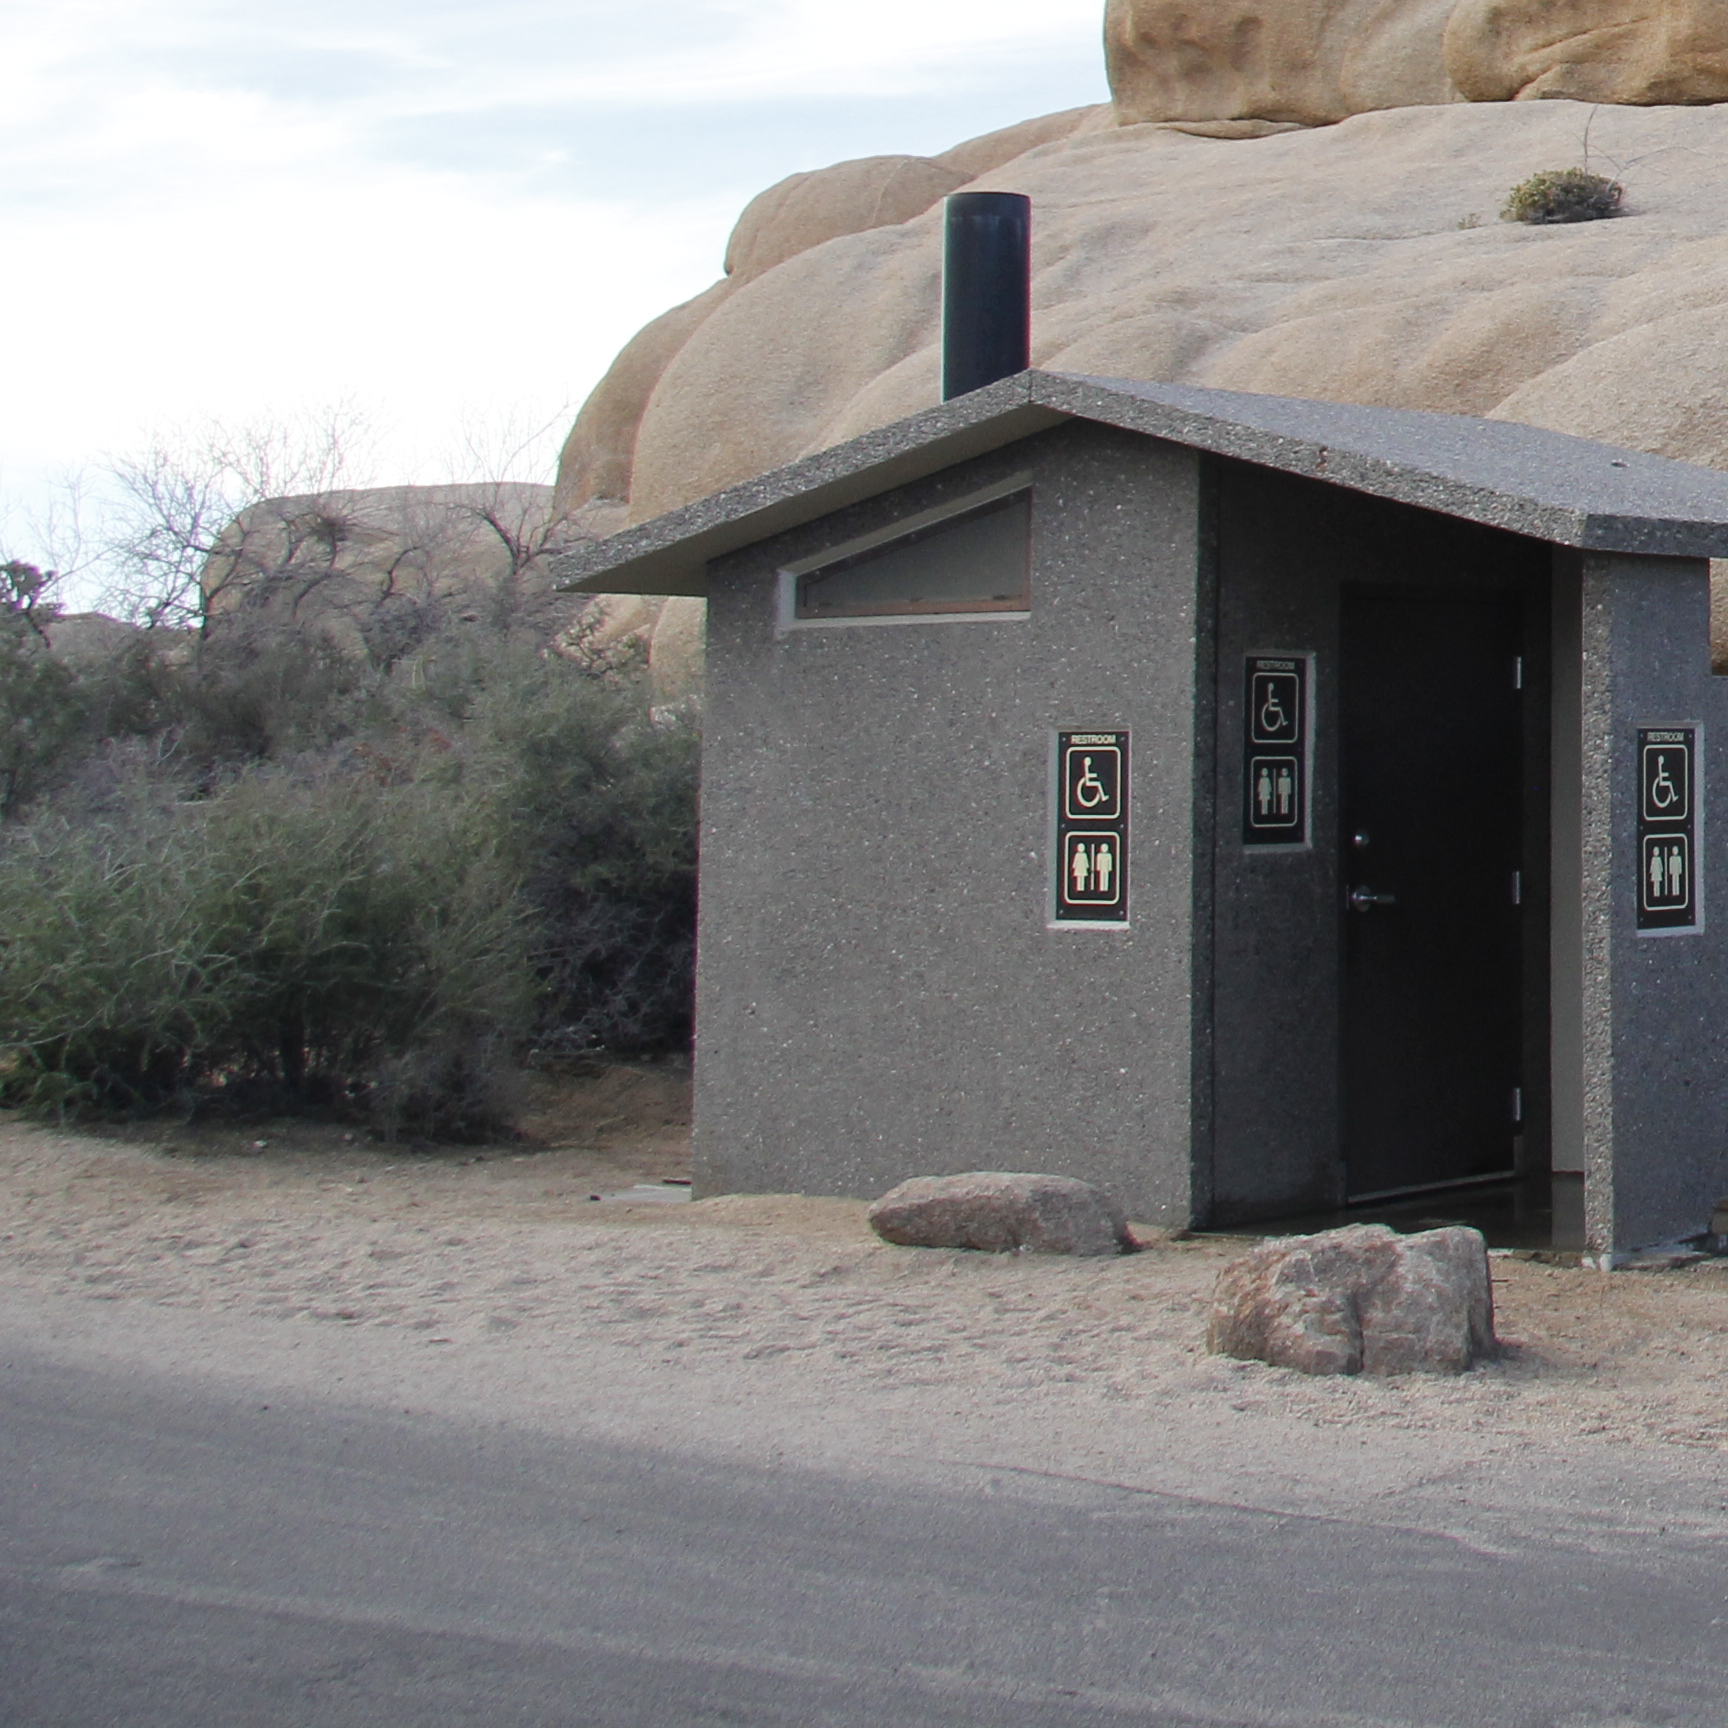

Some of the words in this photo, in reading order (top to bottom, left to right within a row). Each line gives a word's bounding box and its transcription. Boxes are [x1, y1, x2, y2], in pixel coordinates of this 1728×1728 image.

[1256, 660, 1295, 670] RESTROOM
[1071, 734, 1116, 744] RESTROOM
[1647, 731, 1684, 742] RESTROOM
